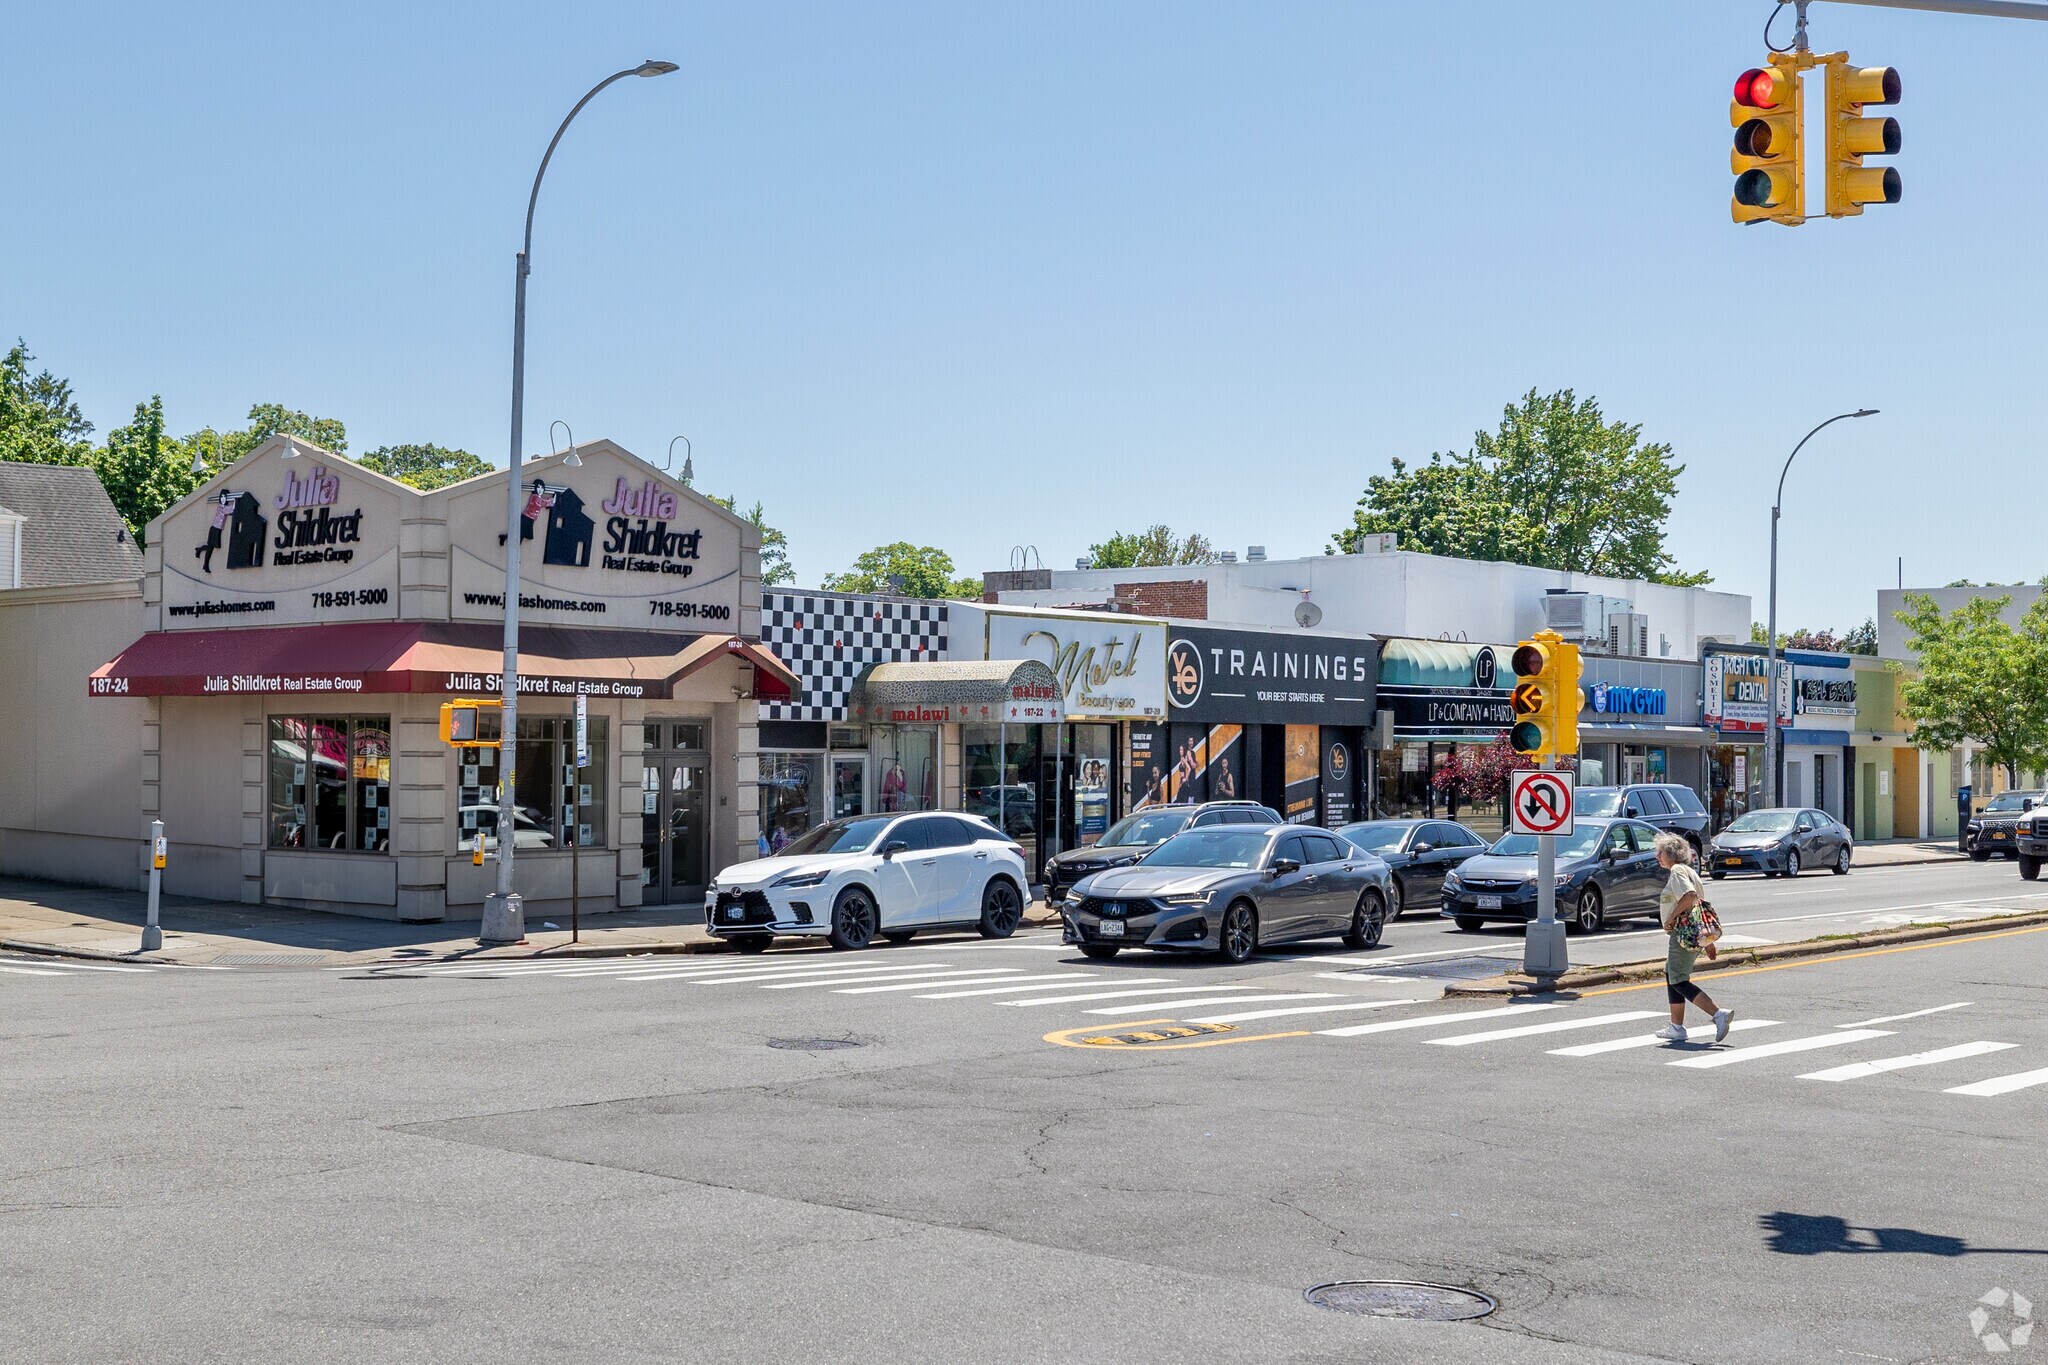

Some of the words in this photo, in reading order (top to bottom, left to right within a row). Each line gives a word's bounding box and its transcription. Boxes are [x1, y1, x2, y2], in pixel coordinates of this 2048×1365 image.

[273, 467, 341, 509] Julia
[601, 477, 679, 520] Julia
[274, 508, 363, 549] Shildkret
[602, 516, 702, 560] Shildkret
[273, 551, 298, 566] Real
[296, 550, 323, 565] Estate
[323, 548, 353, 564] Group
[602, 556, 626, 572] Real
[626, 558, 660, 574] Estate
[659, 561, 693, 578] Group
[169, 599, 275, 617] www.juliashomes.com
[311, 588, 388, 608] 718-591-5000
[464, 592, 606, 613] www.jiashomes.com
[649, 601, 730, 620] 718-591-5000
[1211, 648, 1366, 682] TRAININGS
[1479, 659, 1492, 679] LP
[88, 678, 129, 693] 187-24
[203, 676, 229, 691] Julia
[231, 675, 281, 691] Shildkret
[283, 678, 303, 690] Real
[305, 676, 332, 689] Estate
[334, 676, 362, 691] Group
[445, 673, 481, 690] Julia
[485, 674, 549, 693] Shdkret
[552, 680, 575, 693] Real
[577, 681, 609, 695] Estate
[612, 683, 643, 697] Group
[1709, 658, 1719, 716] COSMETIC
[1738, 682, 1767, 701] DENTAL
[1078, 693, 1114, 711] Beauty
[1256, 691, 1272, 701] YOUR
[1273, 692, 1287, 702] BEST
[1288, 692, 1309, 703] STARTS
[1309, 694, 1325, 703] HERE
[1608, 685, 1632, 713] MY
[1634, 687, 1667, 715] GYM
[892, 705, 949, 721] malawi
[1443, 703, 1483, 722] COMPANY
